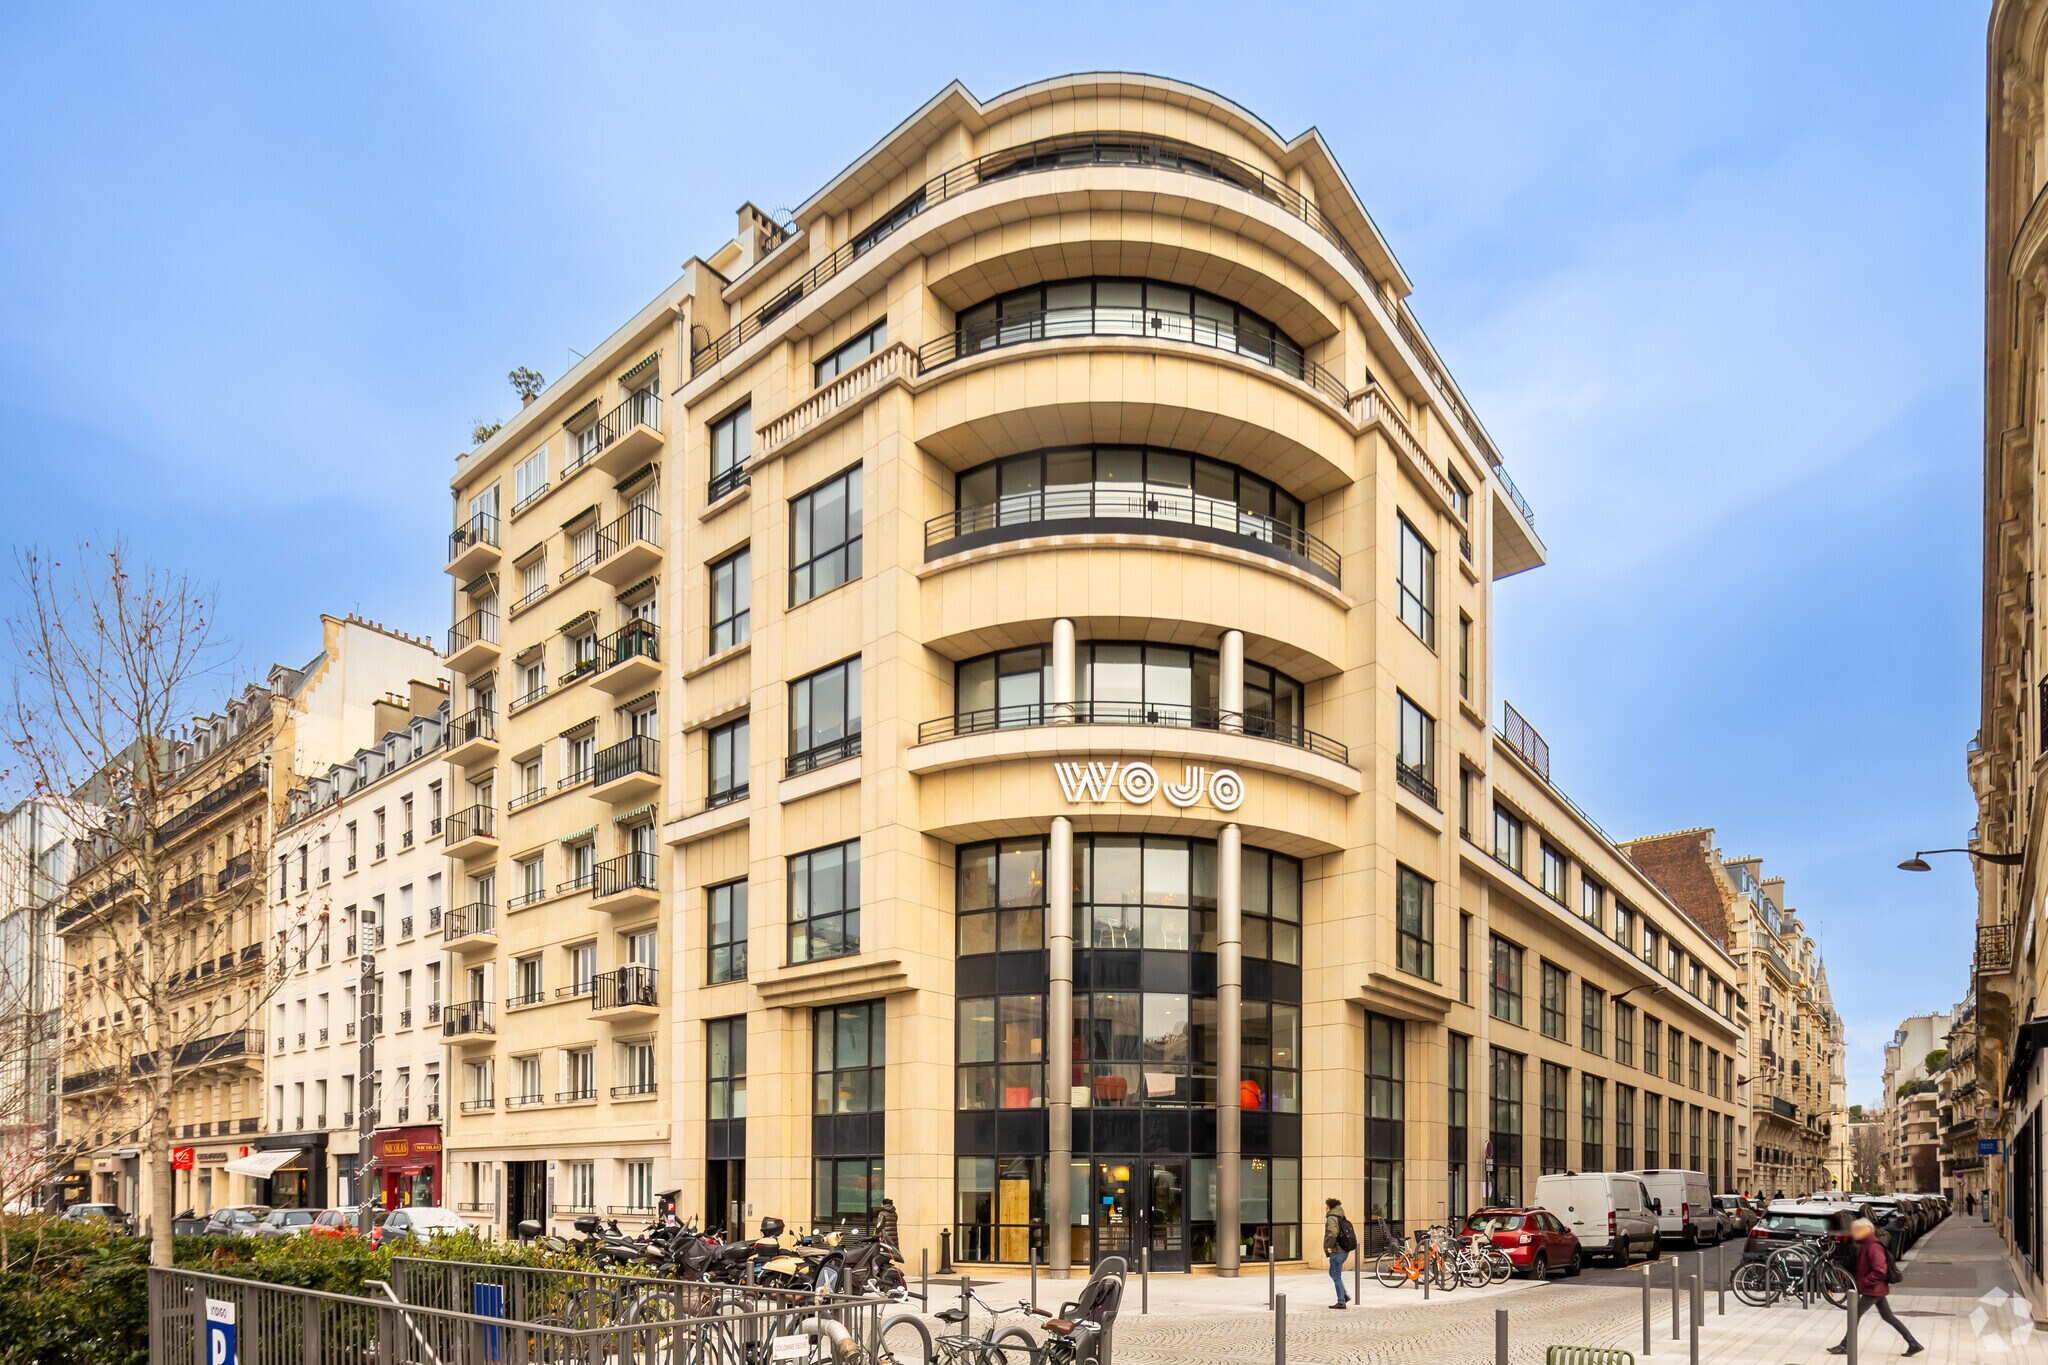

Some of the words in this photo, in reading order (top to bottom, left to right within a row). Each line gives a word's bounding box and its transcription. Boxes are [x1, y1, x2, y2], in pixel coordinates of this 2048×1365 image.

[1054, 761, 1245, 812] WOJO
[384, 1142, 407, 1154] NICOLAS
[212, 1328, 227, 1365] P
